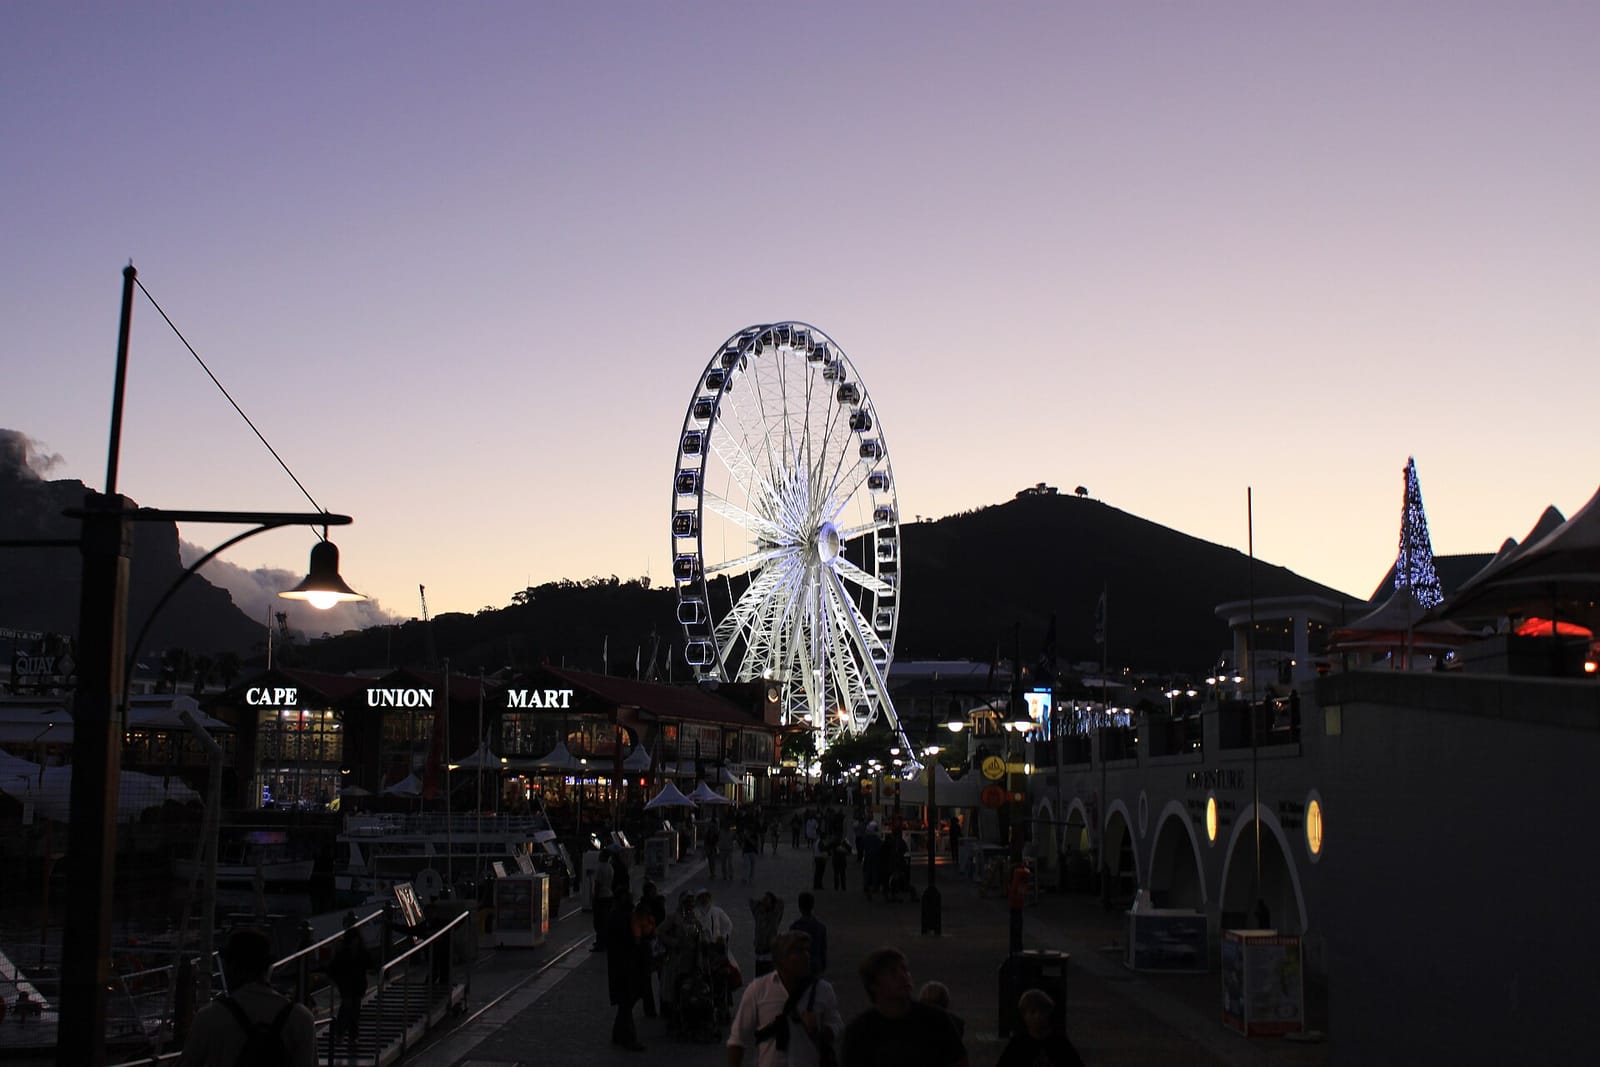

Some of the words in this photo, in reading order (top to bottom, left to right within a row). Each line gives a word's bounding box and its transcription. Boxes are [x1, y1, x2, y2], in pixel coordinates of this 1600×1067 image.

[15, 656, 57, 676] QUAY
[246, 688, 297, 706] CAPE
[367, 688, 434, 707] UNION
[507, 689, 573, 708] MART
